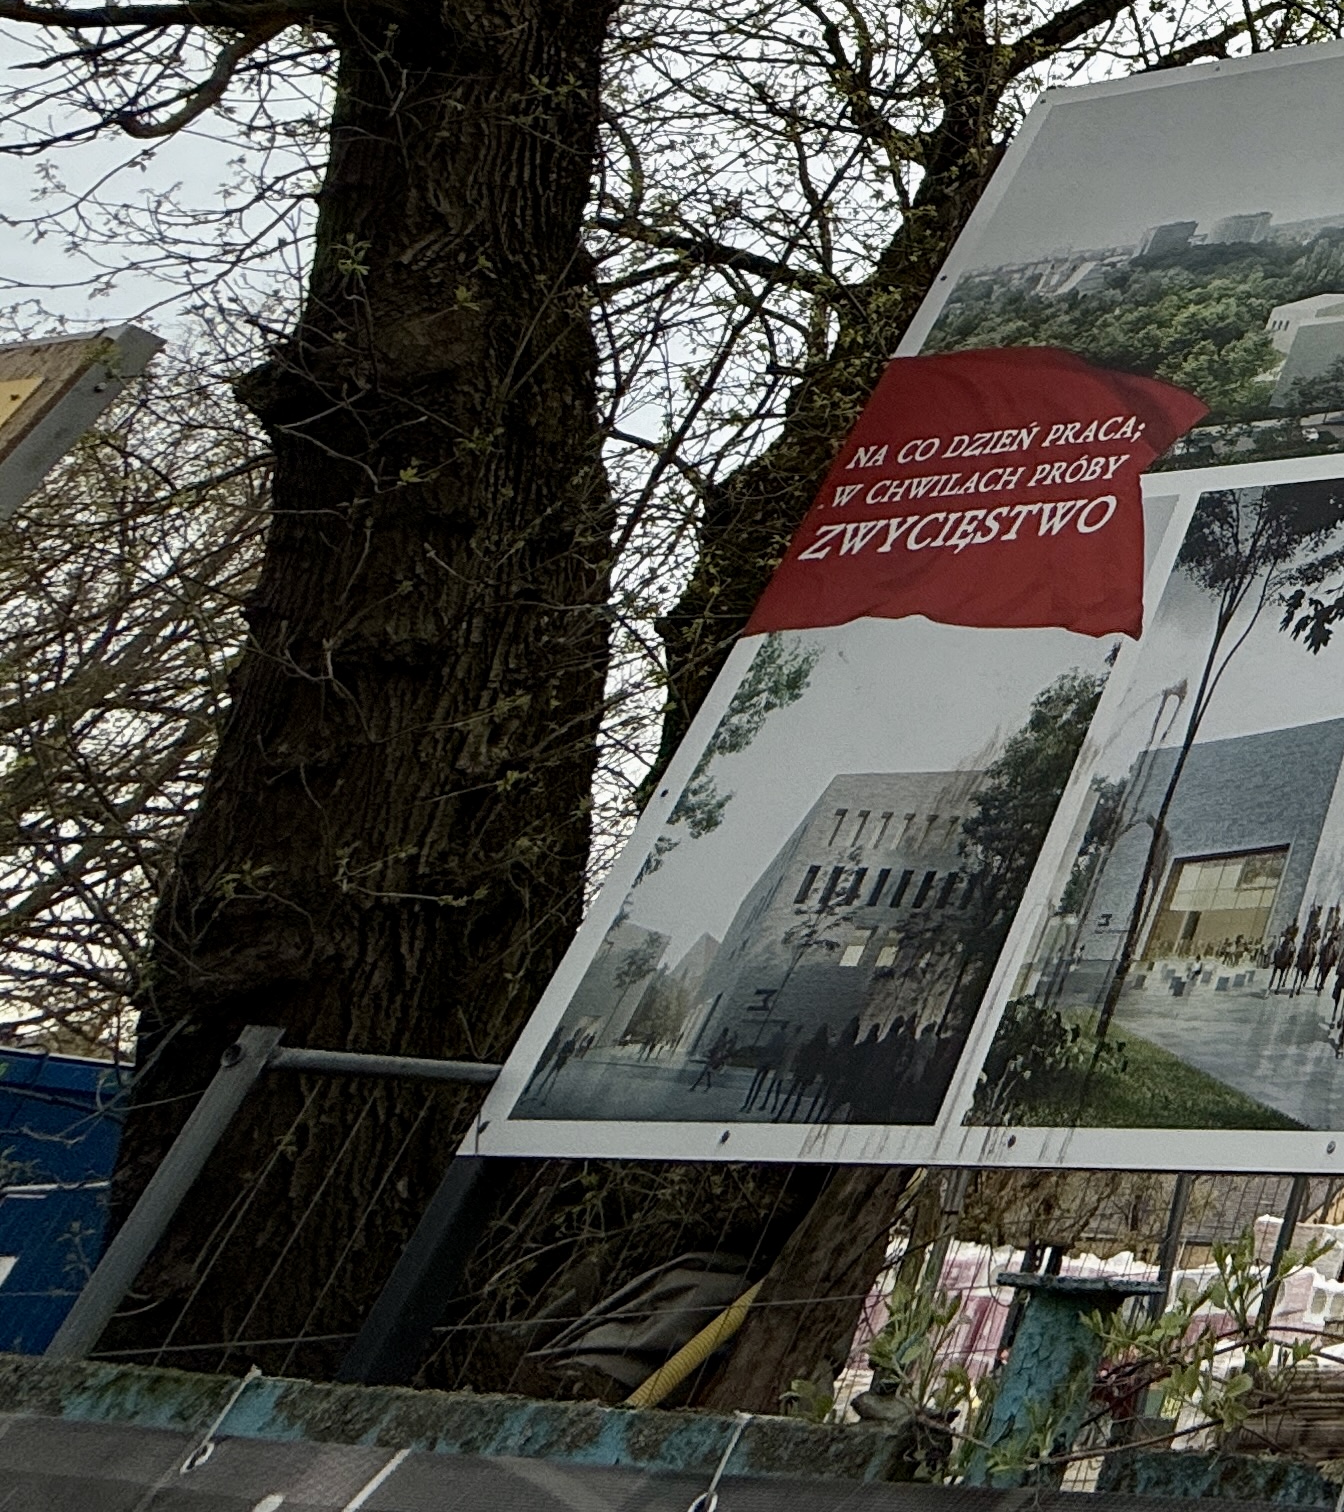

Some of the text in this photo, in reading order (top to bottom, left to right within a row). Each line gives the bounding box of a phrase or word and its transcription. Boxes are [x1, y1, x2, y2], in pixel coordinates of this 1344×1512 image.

[845, 415, 1147, 469] NA CO DZIEŃ PRACA;
[832, 454, 1131, 508] W CHWILACH PRÓBY
[797, 495, 1118, 562] ZWYCIĘSTWO
